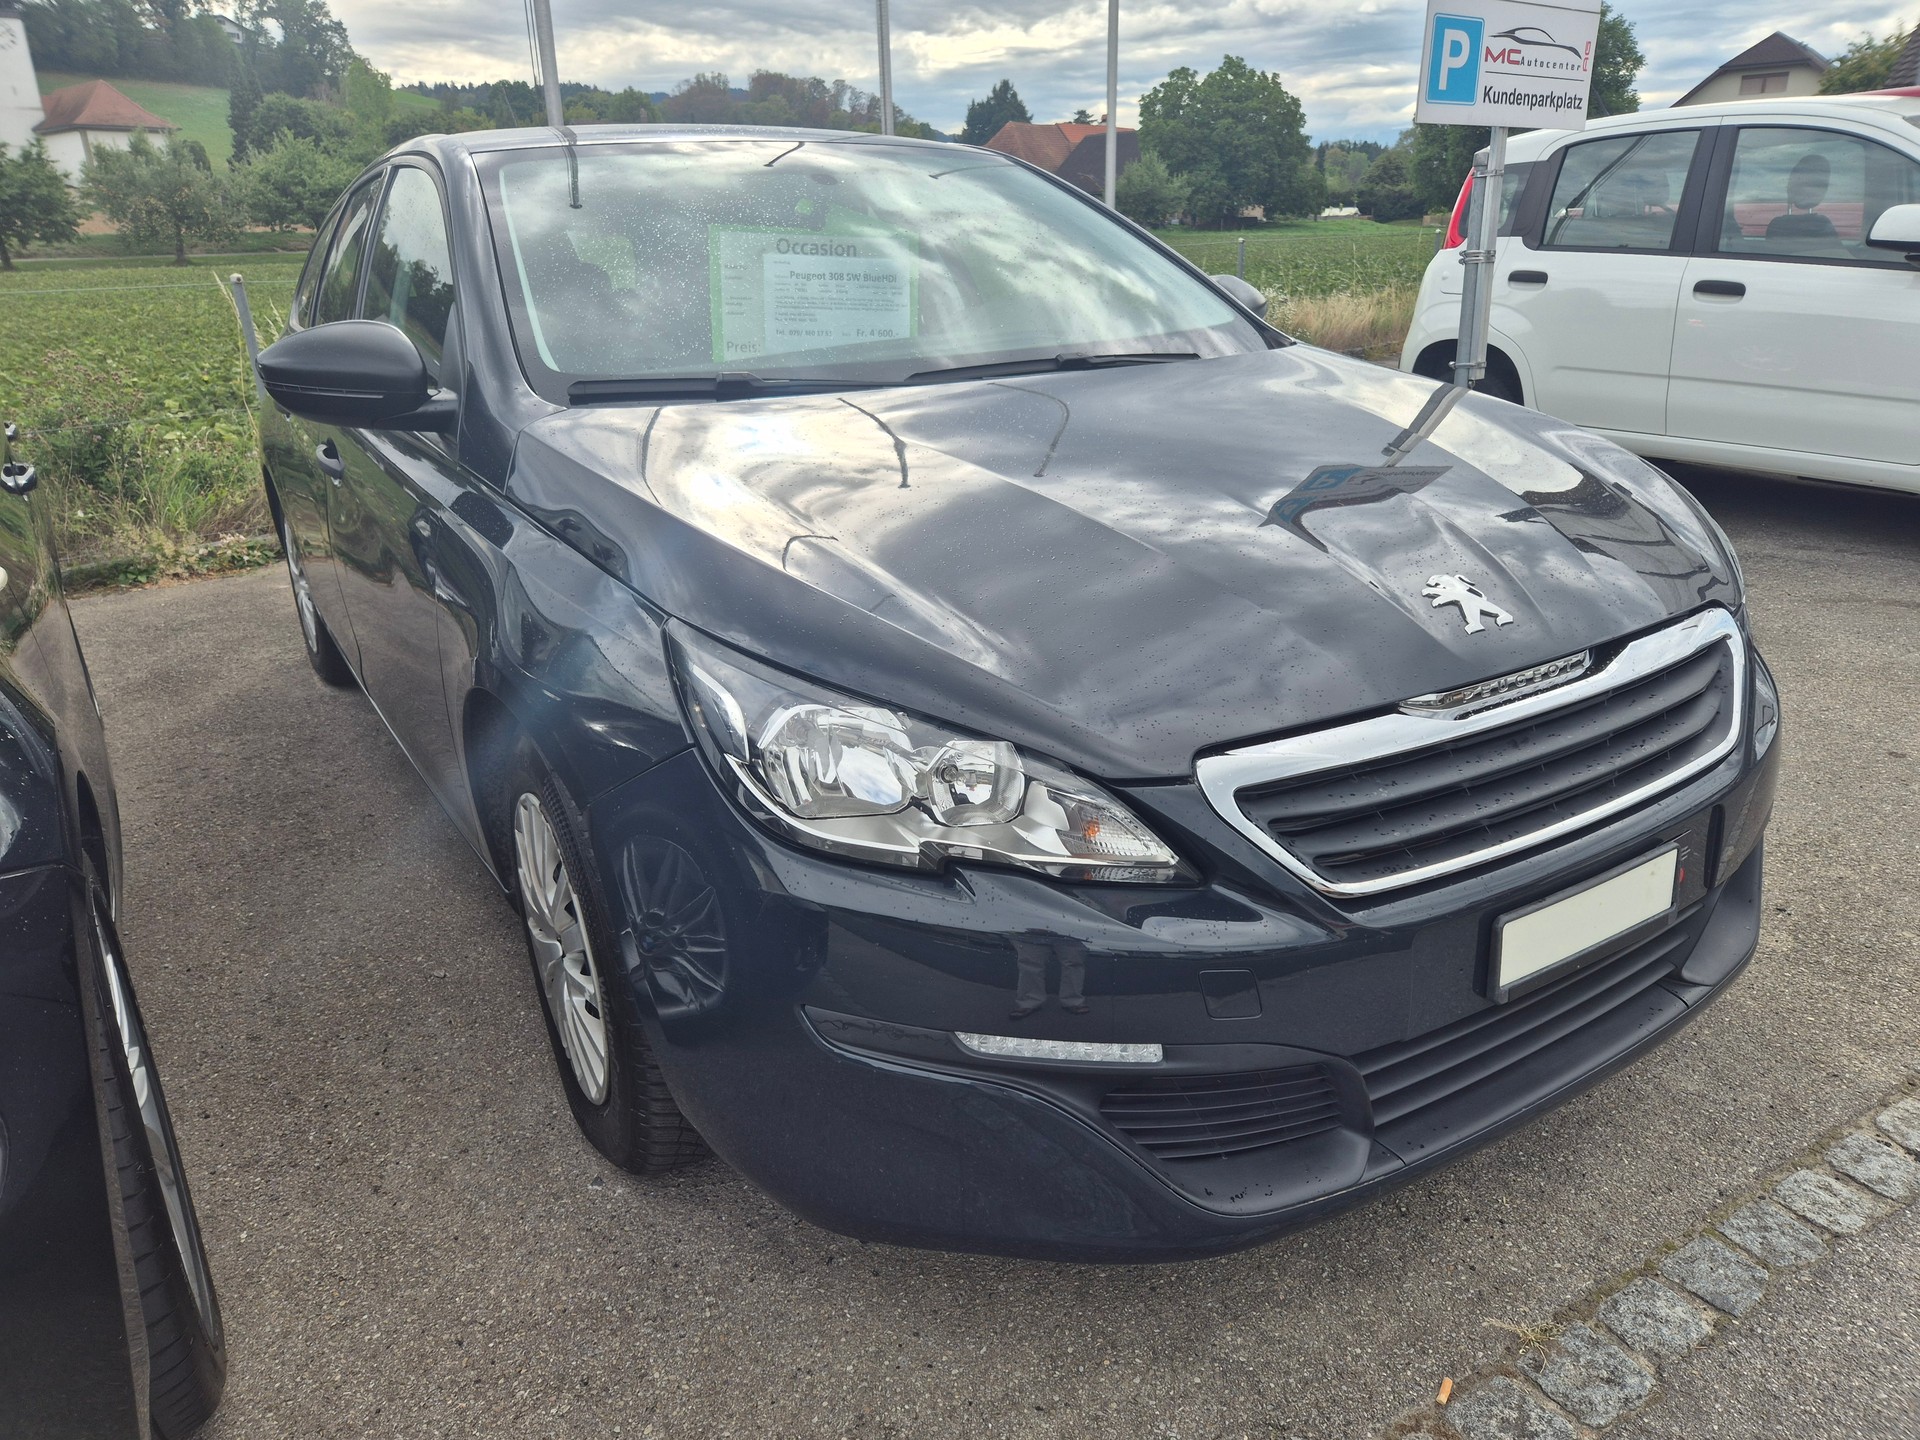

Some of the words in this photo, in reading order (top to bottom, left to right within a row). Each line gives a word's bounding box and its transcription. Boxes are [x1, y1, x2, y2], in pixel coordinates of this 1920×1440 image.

[1438, 28, 1470, 91] P
[1582, 40, 1592, 72] AG
[1483, 85, 1583, 112] Kundenparkplatz
[776, 237, 857, 257] Occasion
[789, 270, 826, 281] Peugeot
[828, 272, 845, 281] 308
[846, 272, 861, 282] SW
[856, 328, 867, 337] Fr.
[726, 341, 761, 353] Preis:
[1462, 663, 1573, 702] PEUGEOT
